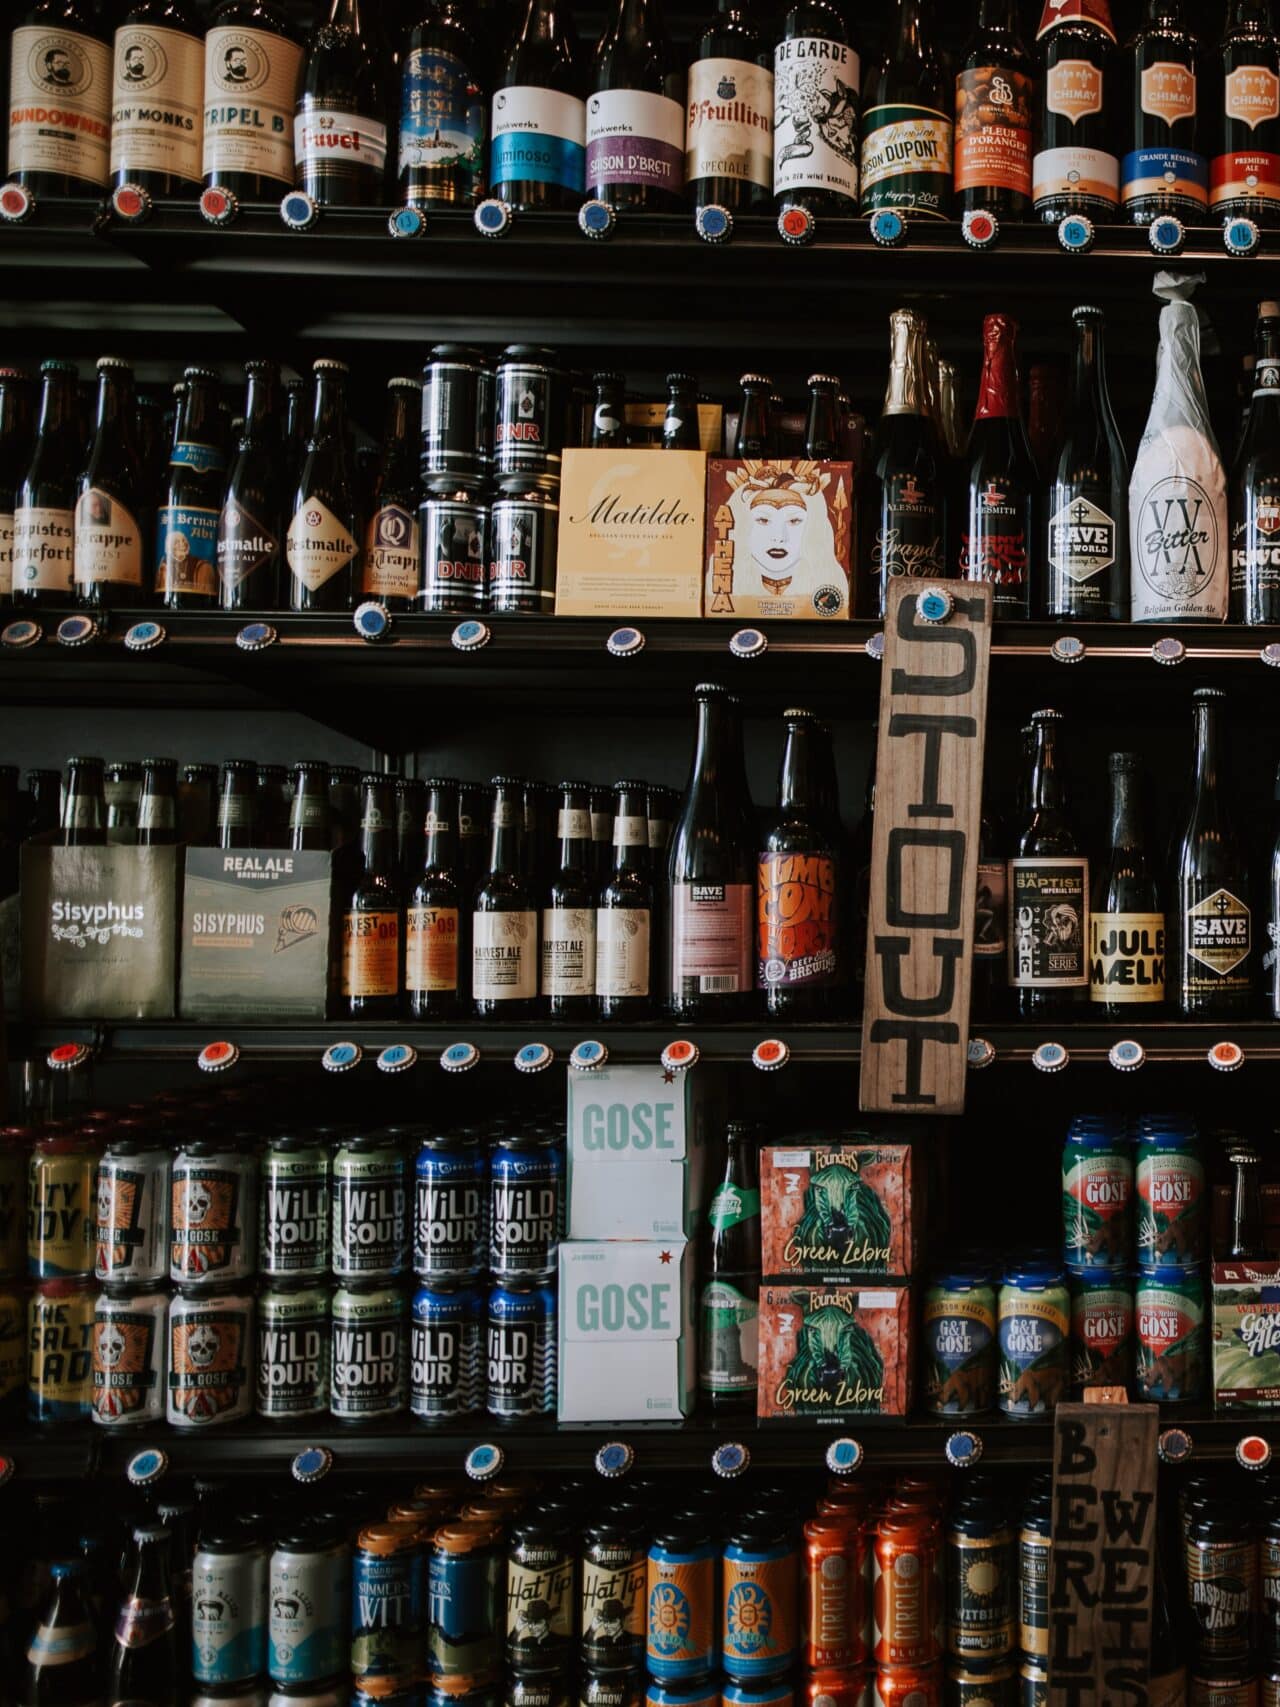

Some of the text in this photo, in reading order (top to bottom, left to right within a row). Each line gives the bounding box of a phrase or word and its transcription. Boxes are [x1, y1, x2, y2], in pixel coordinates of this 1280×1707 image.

[780, 41, 848, 64] DE GARDE
[1054, 90, 1097, 102] CHIMAY
[1149, 92, 1192, 103] CHIMAY
[1231, 95, 1275, 107] CHIMAY
[139, 108, 195, 131] MONKS
[206, 107, 285, 133] TRIPEL B
[981, 125, 1018, 140] FLEUR
[886, 140, 939, 166] DUPONT
[968, 134, 1028, 153] D'ORANGER
[1139, 154, 1169, 165] GRANDE
[1162, 160, 1177, 169] ALE
[1245, 164, 1259, 172] ALE
[917, 191, 940, 205] 2015
[1068, 228, 1081, 240] 15
[496, 423, 541, 442] DNR
[1053, 527, 1109, 545] SAVE
[1145, 527, 1210, 555] Bitter
[711, 505, 736, 613] ATHENA
[1072, 544, 1109, 554] WORLD
[438, 560, 484, 579] DNR
[1143, 603, 1216, 617] Belgian Golden Ale
[869, 593, 985, 1105] STOUT
[223, 857, 294, 874] REAL ALE
[692, 886, 723, 896] SAVE
[1016, 877, 1082, 890] BAPTIST
[51, 900, 145, 924] Sisyphus
[192, 913, 265, 936] SISYPHUS
[437, 917, 456, 934] 09
[1194, 919, 1247, 937] SAVE
[570, 941, 584, 953] ALE
[1194, 935, 1247, 946] THE WORLD
[507, 946, 522, 959] ALE
[791, 955, 813, 968] DEEP
[582, 1102, 675, 1152] GOSE
[814, 1149, 859, 1172] Founders
[493, 1189, 554, 1219] WiLD
[1086, 1183, 1128, 1204] GOSE
[1148, 1183, 1192, 1204] GOSE
[268, 1189, 327, 1220] WiLD
[344, 1190, 406, 1220] WiLD
[418, 1189, 479, 1220] WiLD
[188, 1229, 219, 1242] GOSE
[268, 1220, 327, 1244] SOUR
[344, 1221, 406, 1245] SOUR
[418, 1220, 478, 1244] SOUR
[494, 1220, 553, 1244] SOUR
[784, 1237, 893, 1272] Green Zebra
[576, 1283, 671, 1332] GOSE
[809, 1291, 854, 1314] Founders
[939, 1319, 968, 1338] G&T
[1010, 1319, 1038, 1338] G&T
[1083, 1318, 1125, 1338] GOSE
[1139, 1318, 1178, 1338] GOSE
[259, 1331, 320, 1361] WiLD
[335, 1331, 396, 1361] WiLD
[935, 1335, 972, 1354] GOSE
[1006, 1335, 1042, 1354] GOSE
[192, 1373, 228, 1385] GOSE
[260, 1363, 320, 1386] SOUR
[334, 1363, 395, 1385] SOUR
[776, 1379, 886, 1415] Green Zebra
[507, 1572, 575, 1611] Hat Tip
[583, 1572, 647, 1611] Hat Tip
[820, 1583, 843, 1644] CIRCLE
[893, 1582, 919, 1644] CIRCLE
[1204, 1608, 1236, 1631] JAM
